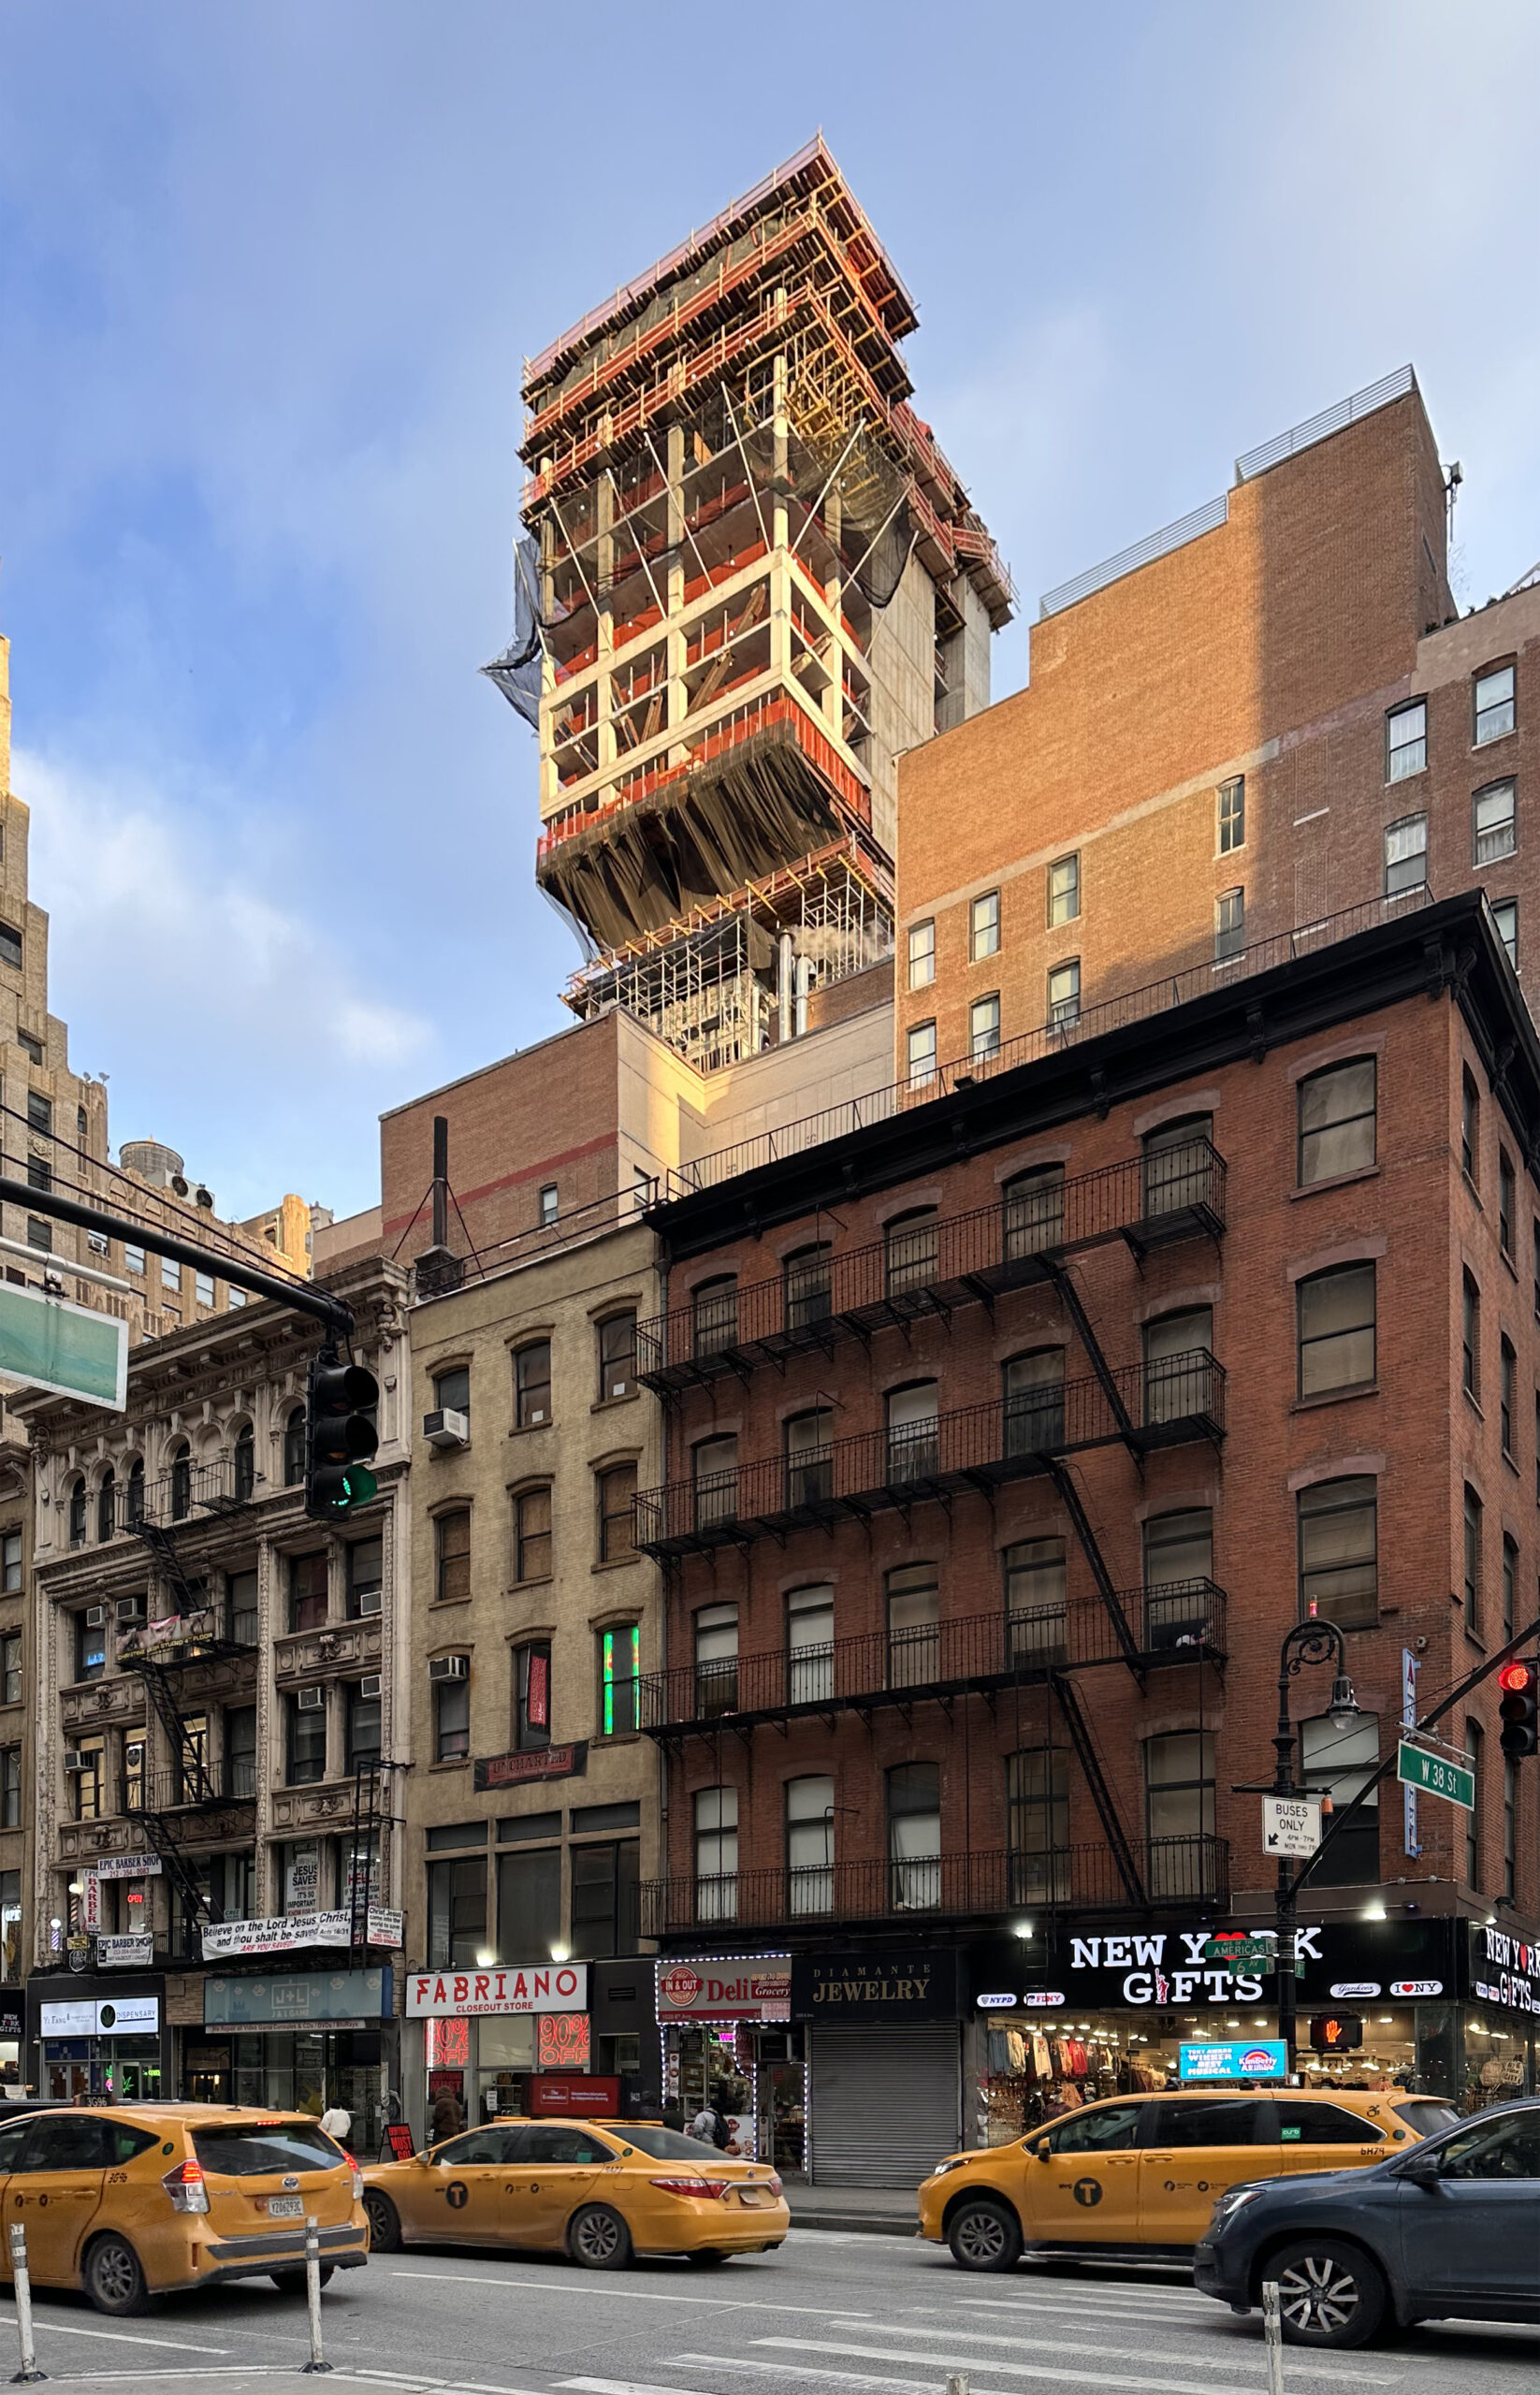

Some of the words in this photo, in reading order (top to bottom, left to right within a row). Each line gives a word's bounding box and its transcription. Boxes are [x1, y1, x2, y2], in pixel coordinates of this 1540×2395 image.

[161, 1640, 184, 1649] STUDIO
[193, 1633, 213, 1642] FLOOR
[493, 1751, 567, 1774] UNCHARTED
[1421, 1759, 1431, 1781] W
[1432, 1764, 1445, 1788] 38
[1447, 1771, 1457, 1794] St
[1276, 1804, 1308, 1818] BUSES
[1279, 1819, 1305, 1831] ONLY
[99, 1859, 114, 1871] EPIC
[115, 1856, 141, 1869] BARBER
[142, 1853, 160, 1866] SHOP
[293, 1864, 318, 1877] JESUS
[292, 1875, 317, 1886] SAVES
[88, 1878, 97, 1923] BARBER
[287, 1899, 316, 1909] IMPORTANT
[369, 1907, 385, 1916] Christ
[386, 1909, 401, 1918] Jesus
[203, 1925, 232, 1938] Believe
[235, 1923, 245, 1933] on
[251, 1921, 264, 1931] the
[267, 1918, 287, 1930] Lord
[291, 1915, 316, 1928] Jesus
[320, 1910, 351, 1924] Christ,
[98, 1938, 111, 1950] EPIC
[112, 1938, 135, 1949] BARBER
[135, 1937, 153, 1947] SHOP
[216, 1937, 232, 1947] and
[234, 1934, 253, 1944] thou
[254, 1931, 277, 1943] shalt
[281, 1930, 292, 1940] be
[295, 1926, 319, 1939] saved
[240, 1944, 254, 1952] ARE
[256, 1942, 270, 1951] YOU
[1069, 1935, 1168, 1968] NEW
[1180, 1927, 1323, 1965] YK
[1213, 1944, 1265, 1956] AMERICAS
[1486, 1926, 1511, 1967] NEW
[813, 1964, 931, 1978] DIAMANTE
[1236, 1961, 1246, 1974] 6
[416, 1969, 577, 2005] FABRIANO
[666, 1980, 674, 1991] IN
[675, 1980, 680, 1990] &
[682, 1980, 697, 1990] OUT
[706, 1978, 750, 2002] Deli
[755, 1986, 791, 1997] Grocery
[812, 1979, 930, 2003] JEWELRY
[1123, 1968, 1263, 2004] GFTS
[1338, 1983, 1373, 1995] Yankees
[1414, 1982, 1438, 1993] NY
[1500, 1971, 1532, 2011] GFTS
[1036, 1995, 1062, 2003] FDNY
[289, 2009, 310, 2017] GAME
[456, 2002, 502, 2013] CLOSEOUT
[503, 2001, 533, 2011] STORE
[116, 2010, 155, 2019] DISPENSARY
[427, 2017, 469, 2049] 0%
[540, 2013, 589, 2049] 90%
[433, 2047, 469, 2066] OFF
[539, 2047, 589, 2066] OFF
[1188, 2054, 1232, 2062] WINNER
[1238, 2056, 1278, 2067] Kimberly
[430, 2080, 462, 2093] MUST
[87, 2097, 108, 2107] 3G96
[390, 2136, 412, 2151] MUST
[108, 2171, 128, 2184] 3G96
[451, 2185, 464, 2207] T
[1079, 2183, 1097, 2204] T
